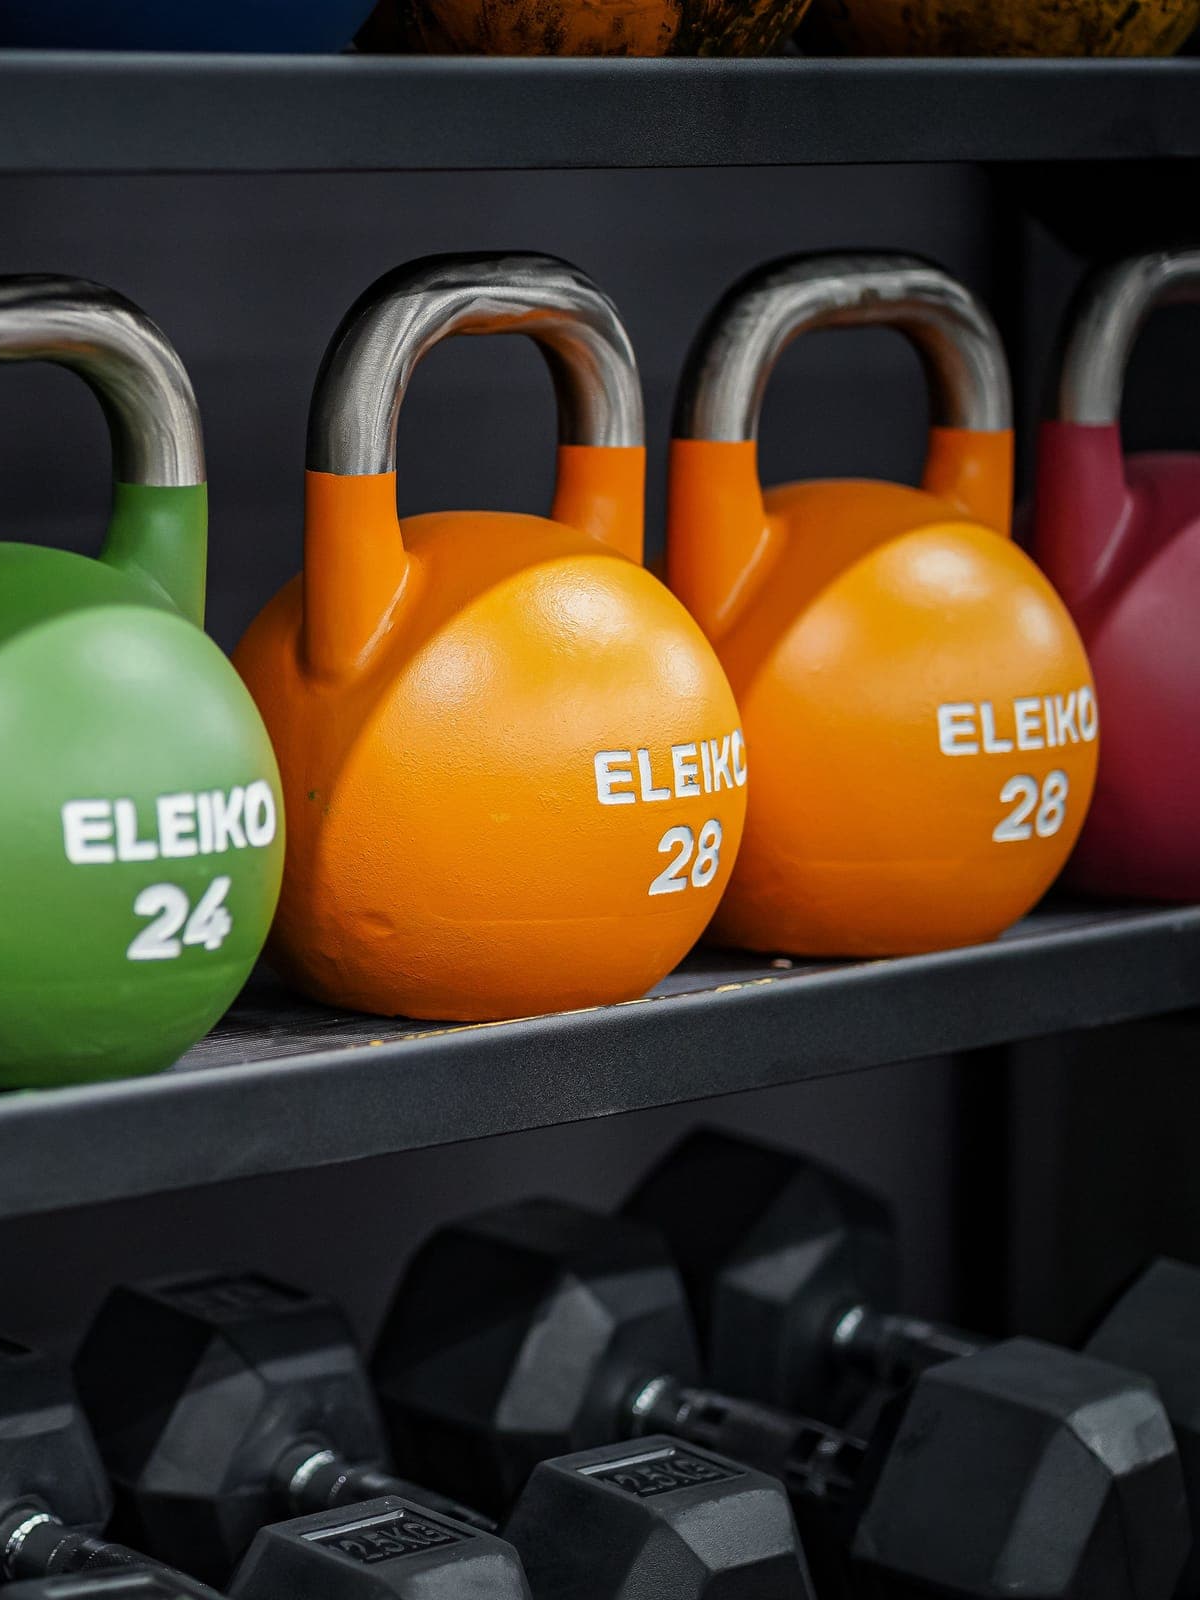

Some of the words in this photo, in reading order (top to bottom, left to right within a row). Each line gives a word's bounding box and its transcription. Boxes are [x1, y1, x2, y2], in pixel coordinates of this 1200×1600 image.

[937, 684, 1098, 756] ELEIKO
[594, 728, 747, 804] ELEIKO
[62, 780, 276, 864] ELEIKO
[992, 768, 1068, 842] 28
[648, 818, 722, 895] 28
[127, 875, 232, 960] 24
